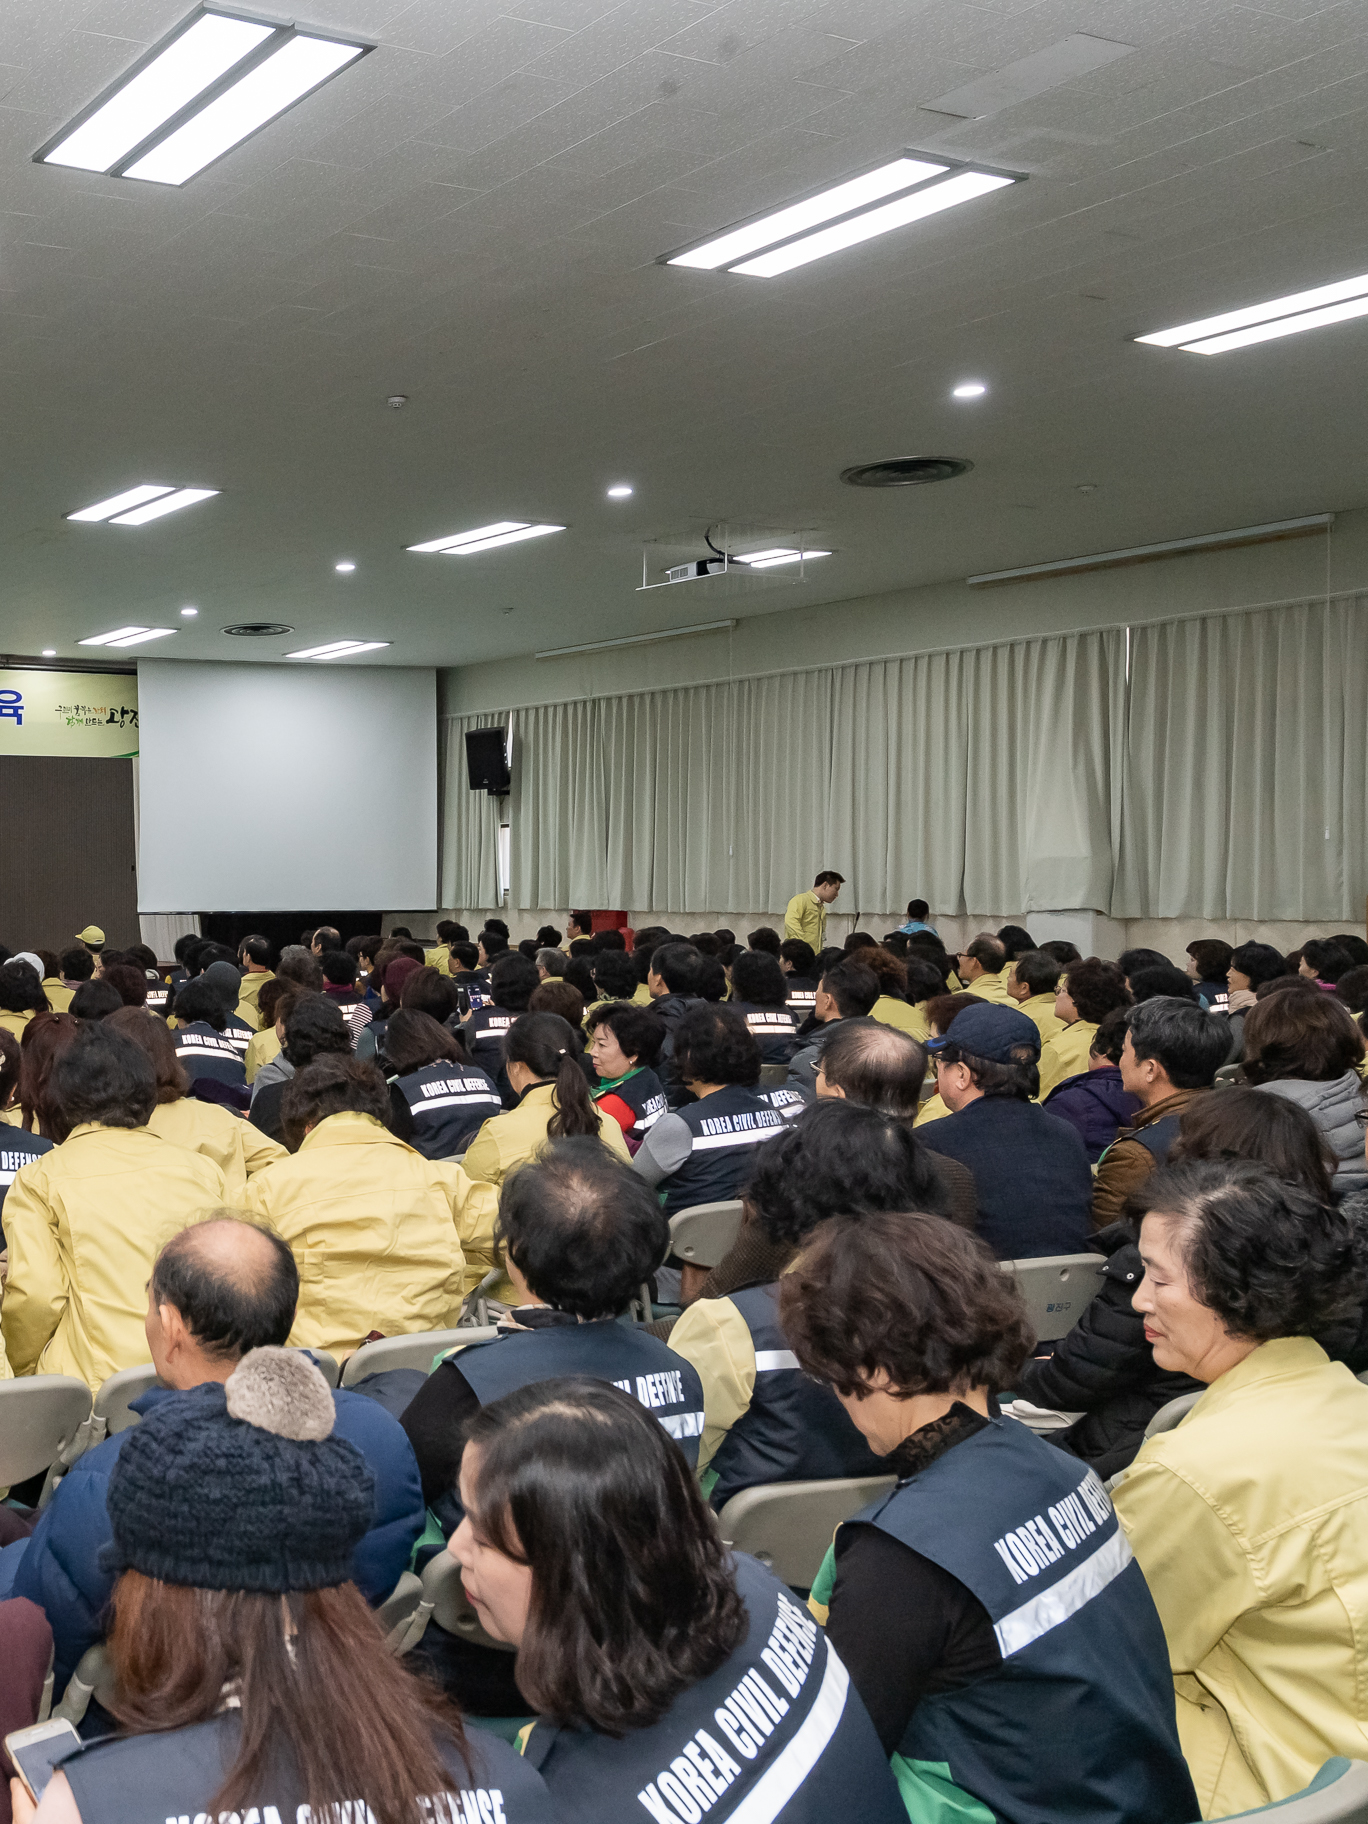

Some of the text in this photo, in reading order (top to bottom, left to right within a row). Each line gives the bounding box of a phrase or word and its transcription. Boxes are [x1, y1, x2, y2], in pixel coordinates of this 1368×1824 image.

[488, 1016, 511, 1028] KOREA
[181, 1033, 204, 1045] KOREA
[203, 1035, 219, 1048] CIVIL
[420, 1077, 490, 1098] KOREA CIVIL DEFENSE
[700, 1115, 734, 1136] KOREA
[732, 1111, 757, 1132] CIVIL
[1046, 1301, 1072, 1313] 광진구
[993, 1514, 1066, 1585] KOREA
[1047, 1491, 1096, 1550] CIVIL
[637, 1591, 818, 1824] KOREA CIVIL DEFENSE
